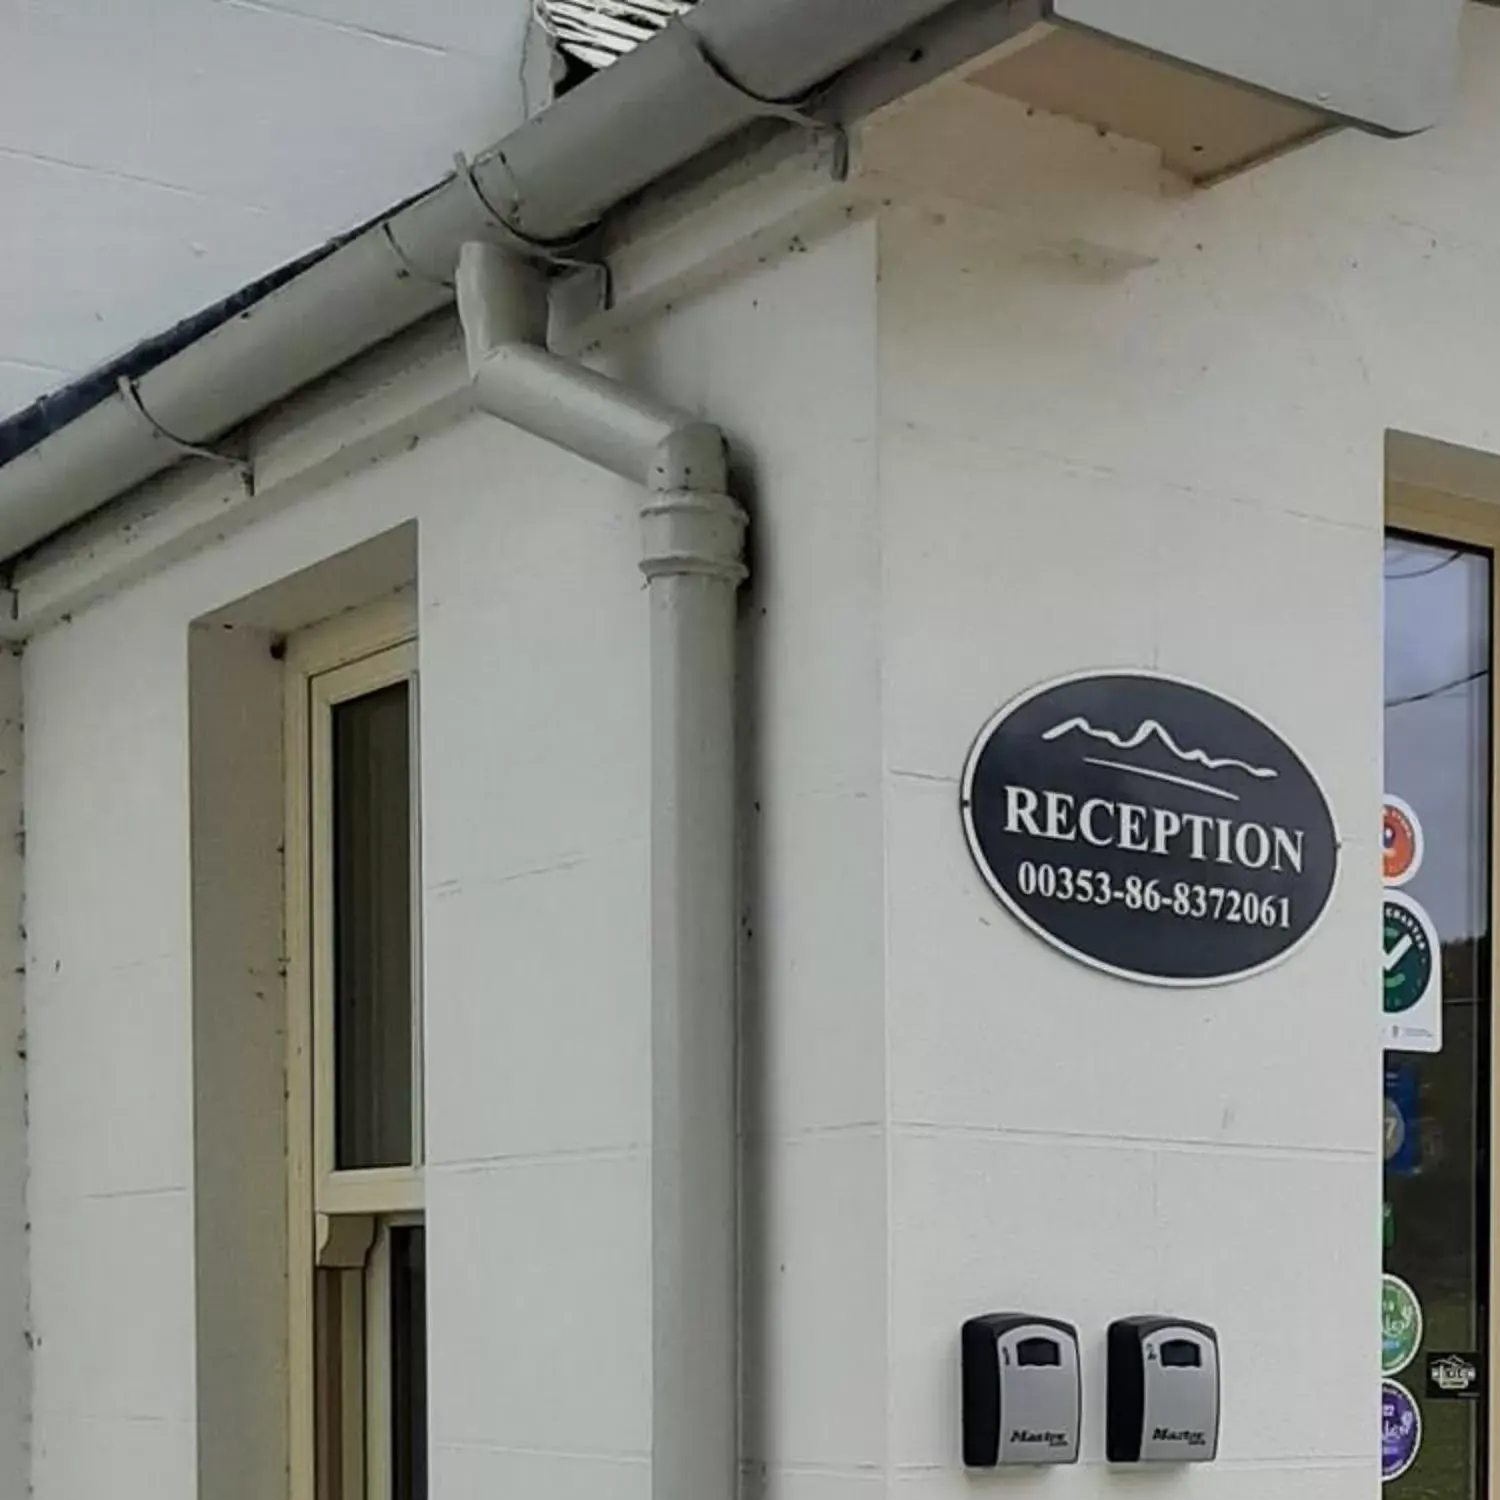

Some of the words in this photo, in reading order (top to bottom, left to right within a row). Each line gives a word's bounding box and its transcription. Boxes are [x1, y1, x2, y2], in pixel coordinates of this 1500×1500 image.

[1003, 784, 1305, 874] RECEPTION
[1017, 860, 1291, 929] 00353-86-8372061
[1010, 1429, 1066, 1443] Master
[1151, 1427, 1205, 1442] Master
